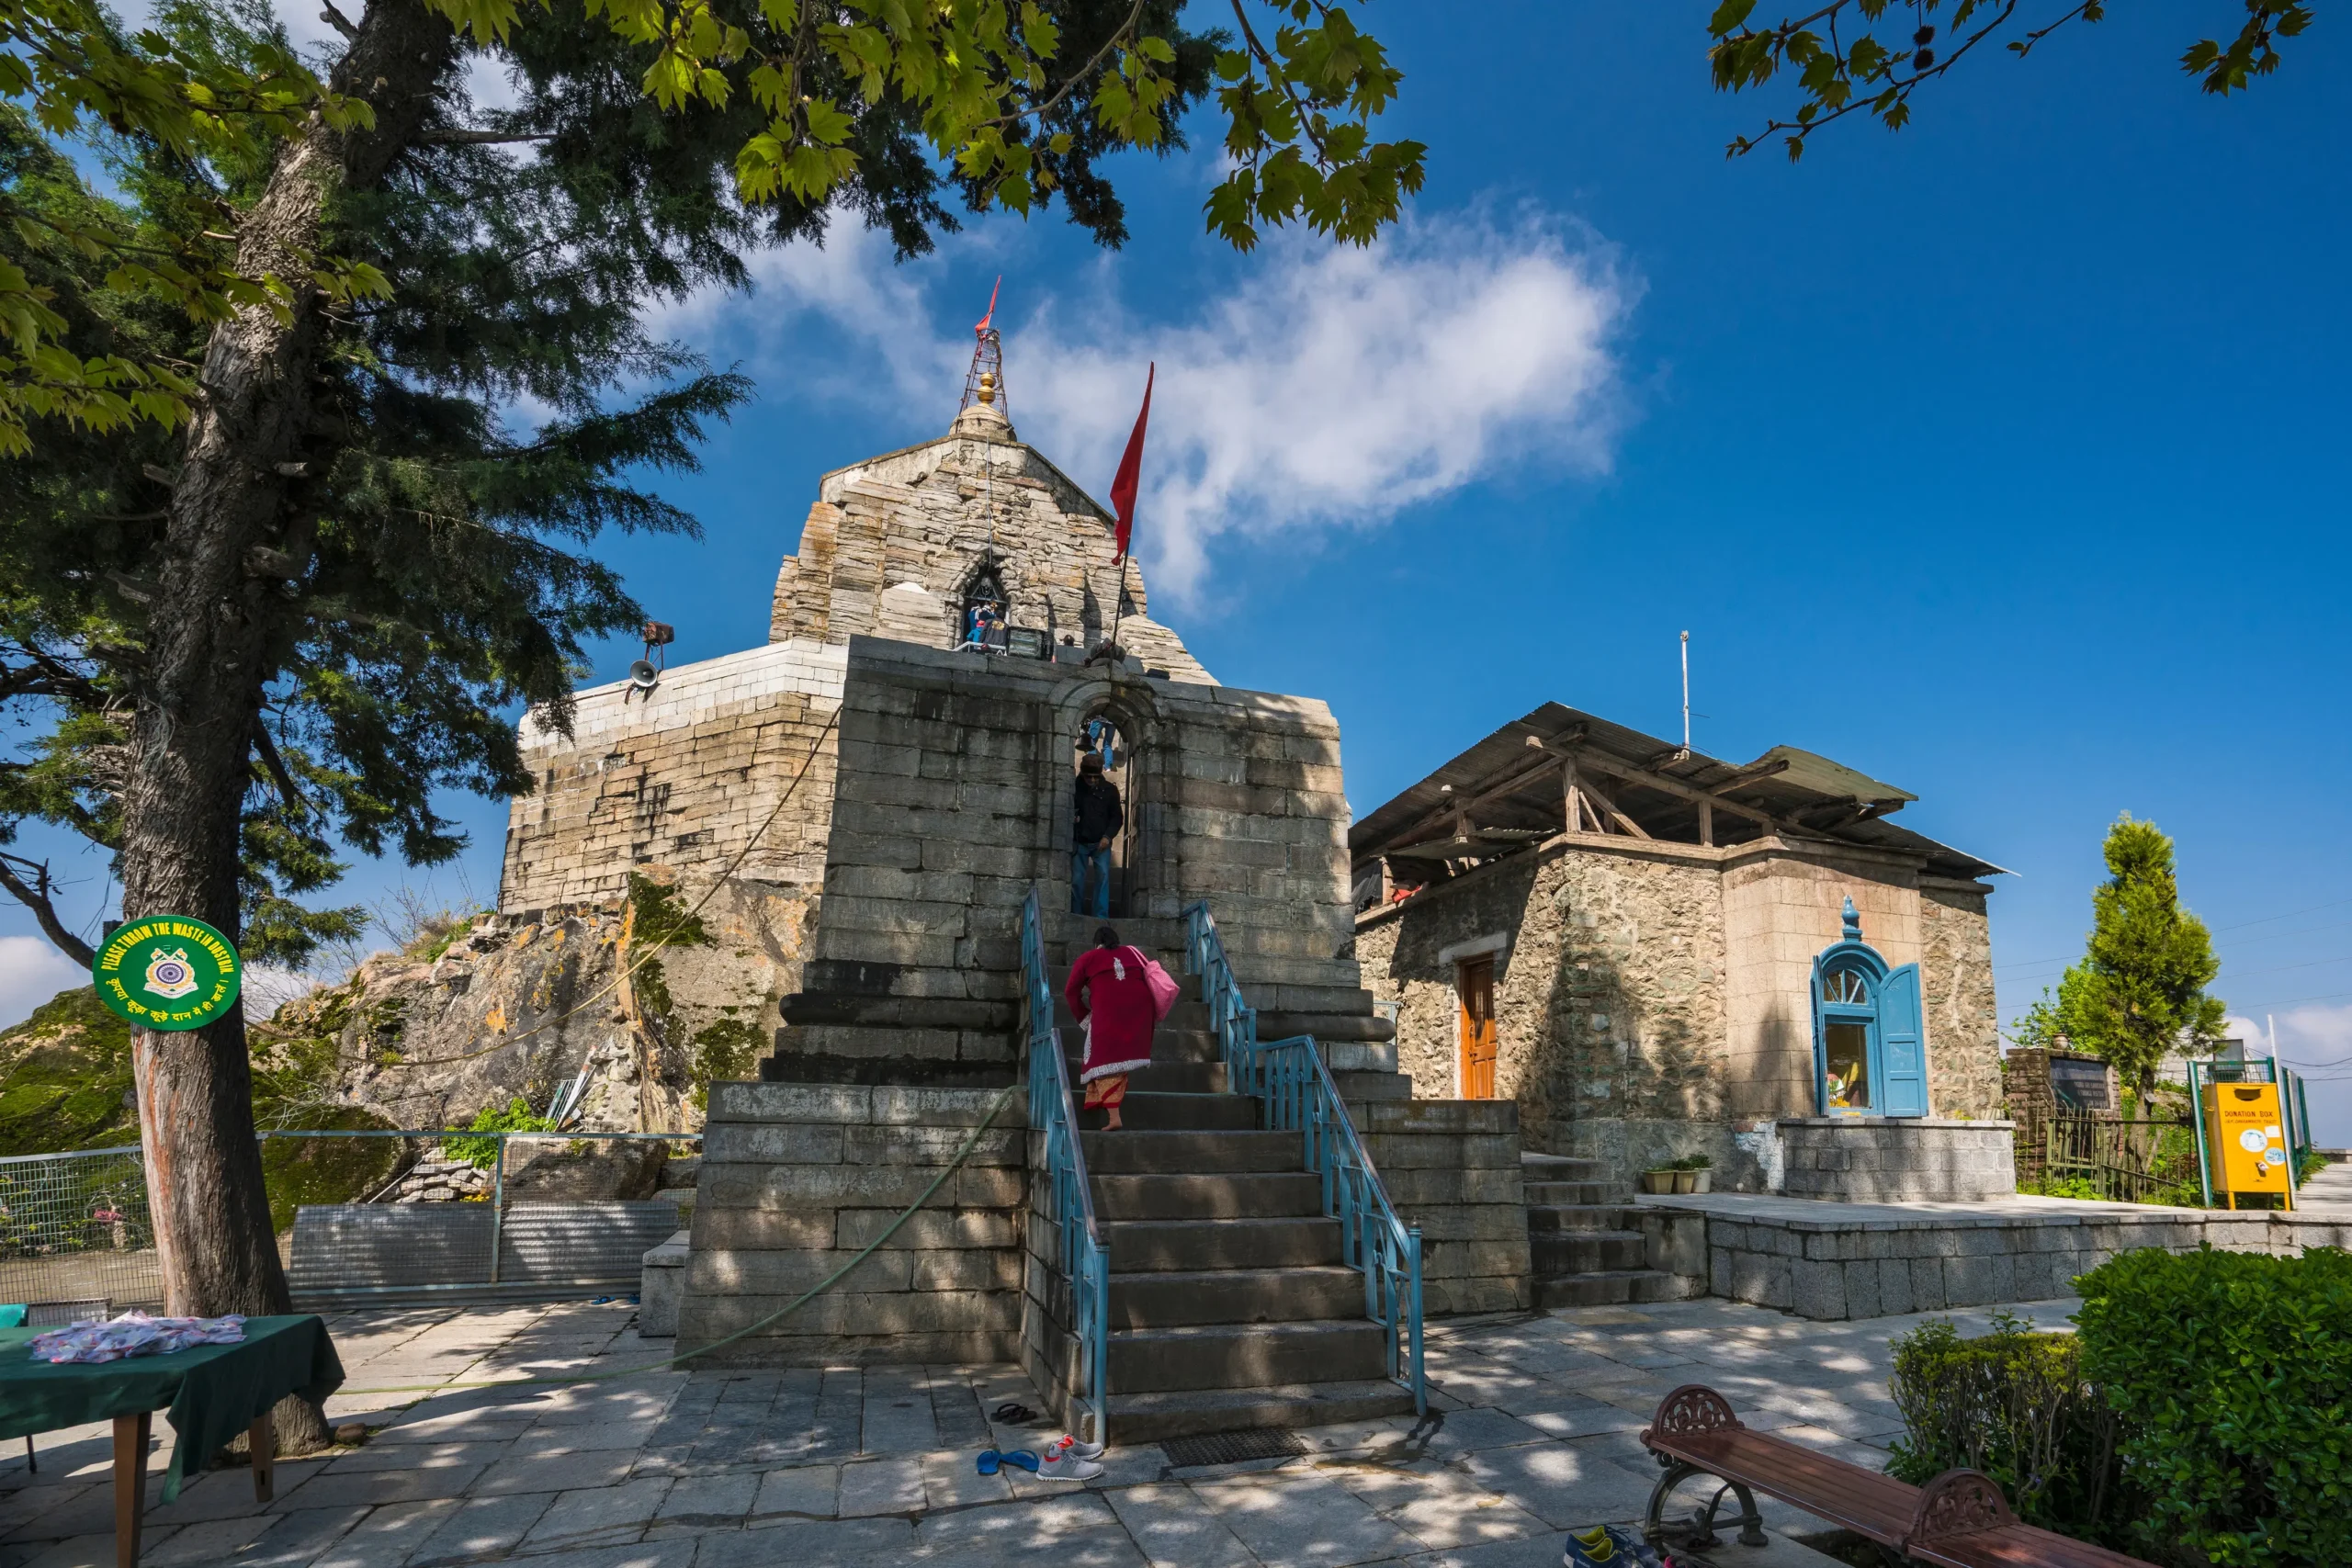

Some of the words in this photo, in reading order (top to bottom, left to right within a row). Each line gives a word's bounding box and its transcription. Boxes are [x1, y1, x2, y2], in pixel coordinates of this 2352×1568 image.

[101, 943, 128, 971] PLEASE
[116, 925, 153, 948] THROW
[152, 922, 171, 936] THE
[172, 921, 205, 942] WASTE
[199, 933, 215, 947] IN
[106, 976, 130, 1000] कृपया
[172, 1011, 192, 1021] दान
[192, 1006, 203, 1016] में
[202, 1001, 214, 1011] ही
